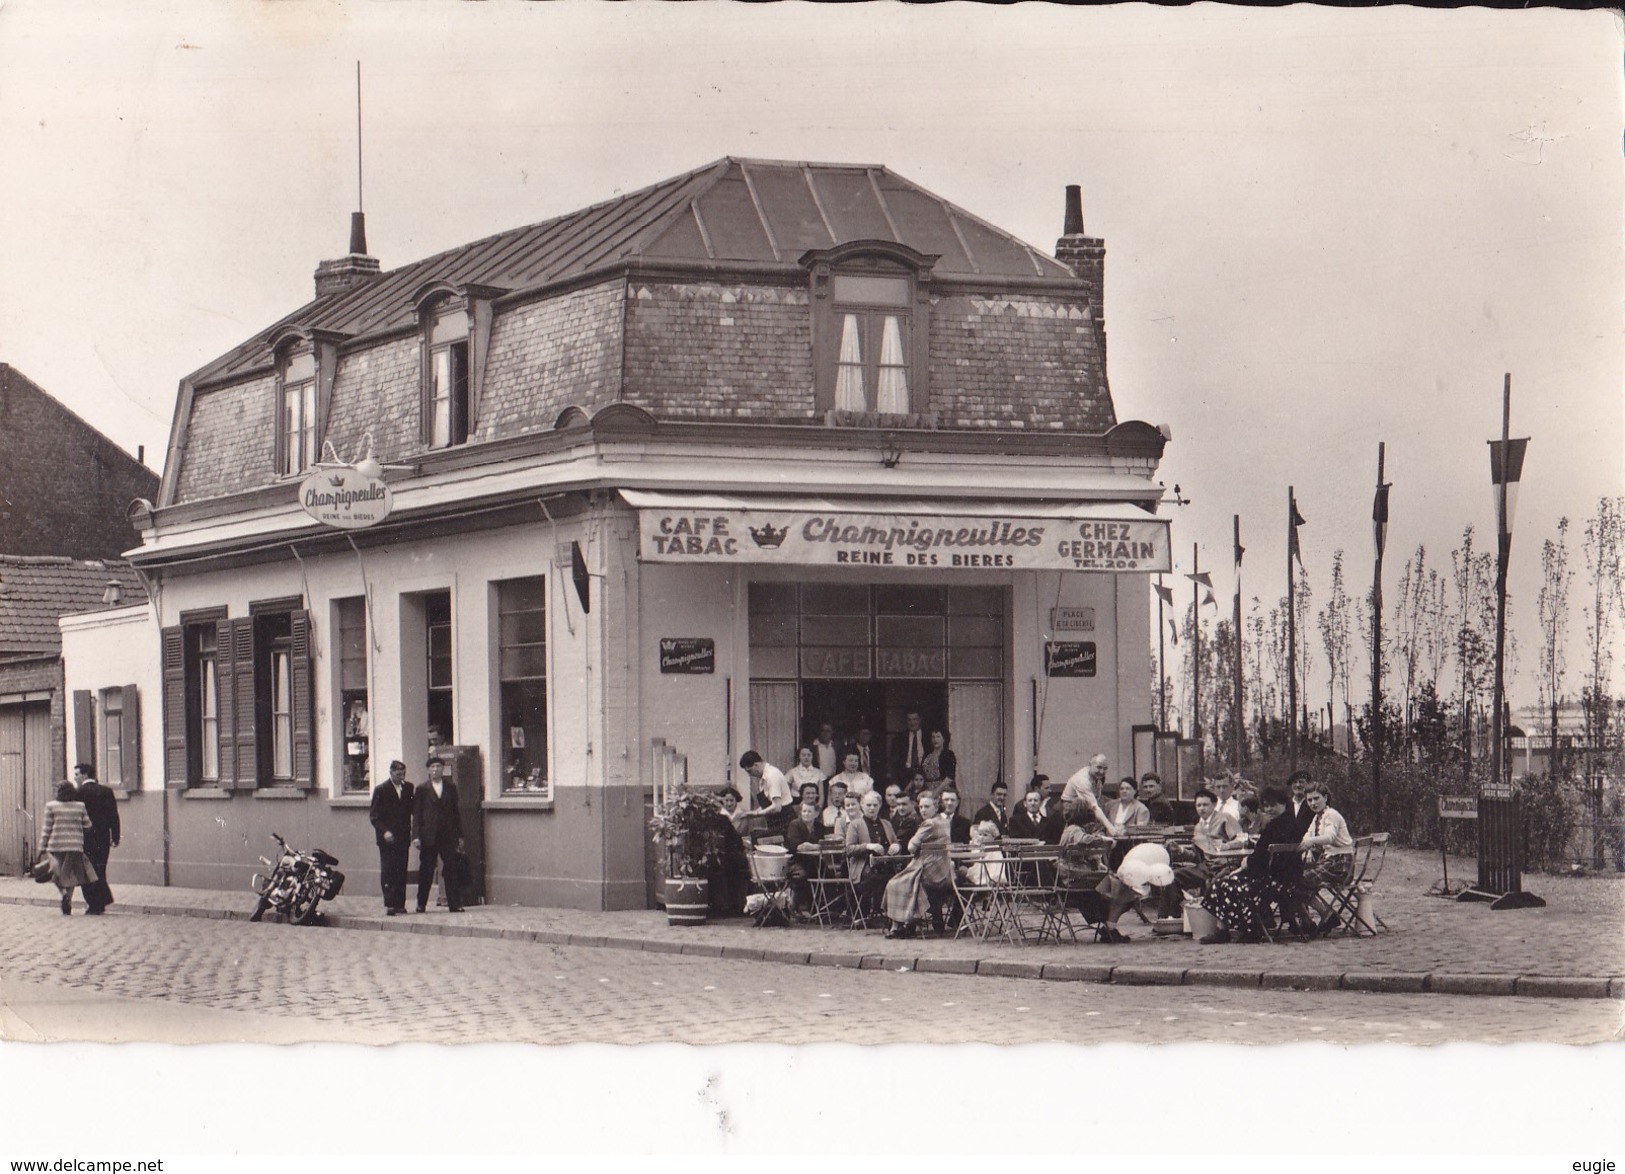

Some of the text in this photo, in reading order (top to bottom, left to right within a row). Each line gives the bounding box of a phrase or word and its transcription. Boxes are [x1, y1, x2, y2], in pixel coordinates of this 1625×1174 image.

[305, 483, 386, 511] Champigneulles
[802, 517, 1046, 550] Champigneulles
[1080, 523, 1131, 541] CHEZ
[652, 535, 738, 555] TABAC
[1058, 540, 1155, 559] GERMAIN
[907, 553, 938, 565] DES
[952, 554, 1014, 567] BIERES
